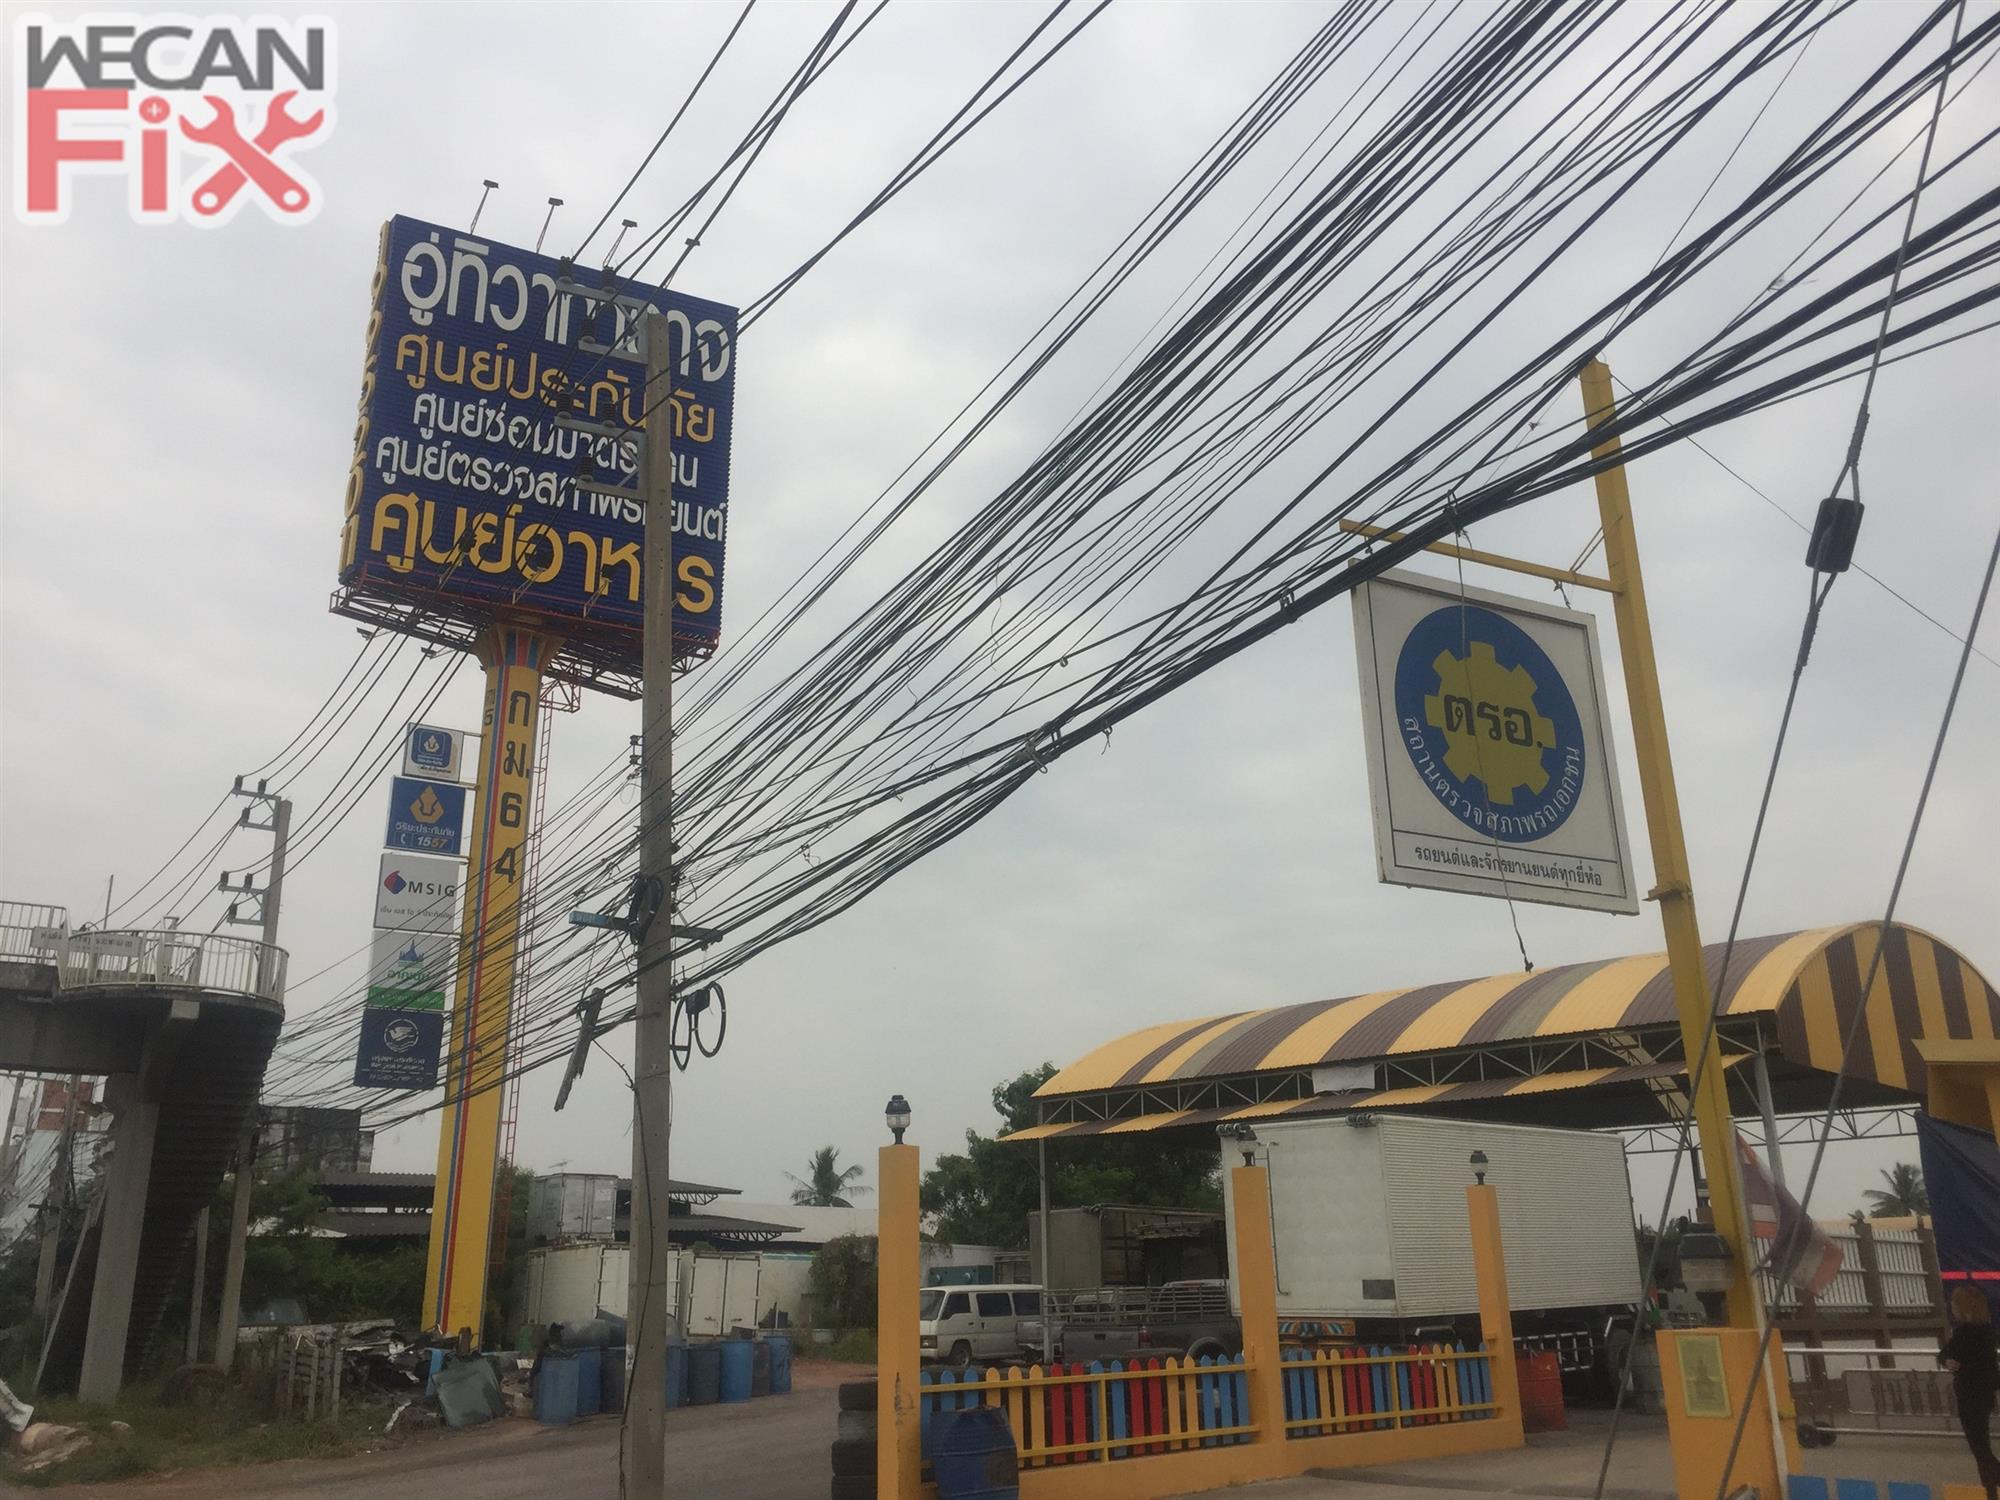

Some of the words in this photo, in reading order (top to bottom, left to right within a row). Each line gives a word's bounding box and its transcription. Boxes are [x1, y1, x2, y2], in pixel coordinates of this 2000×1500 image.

[370, 491, 715, 614] ศูนย์อาหร
[1443, 694, 1543, 748] ตรอ.
[408, 881, 457, 897] MSIG
